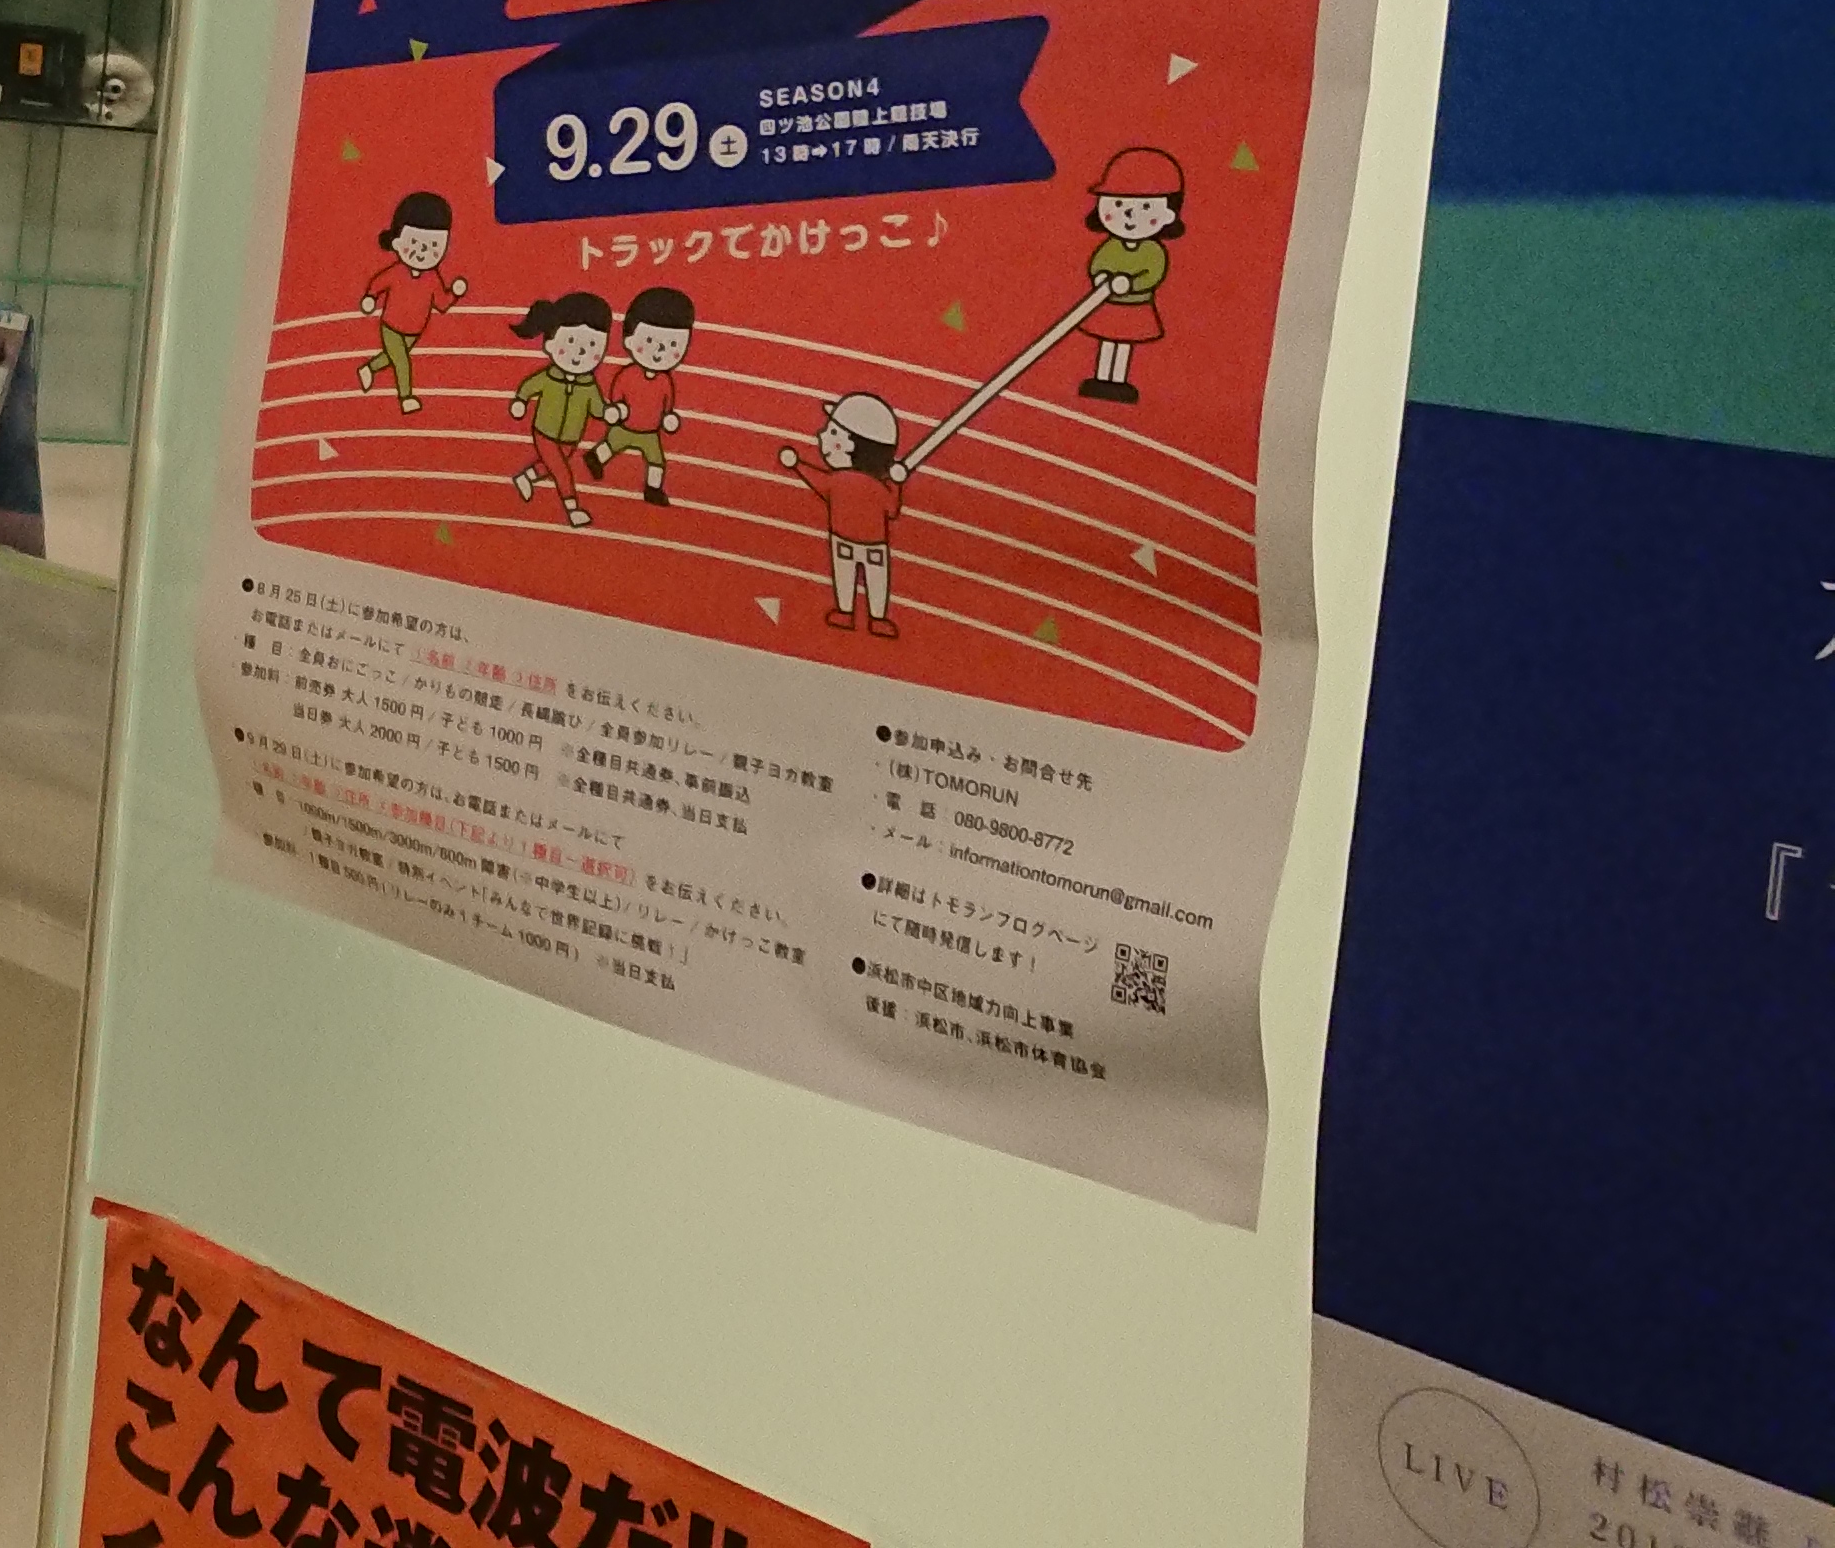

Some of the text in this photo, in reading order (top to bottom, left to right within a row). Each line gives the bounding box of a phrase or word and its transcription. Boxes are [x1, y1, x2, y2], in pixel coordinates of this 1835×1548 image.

[759, 76, 880, 109] SEASON4
[546, 100, 699, 181] 9.29
[953, 810, 1076, 857] 080-9800-8772
[948, 842, 1215, 932] informationtomorun@gmail.com
[1404, 1442, 1510, 1510] LIVE
